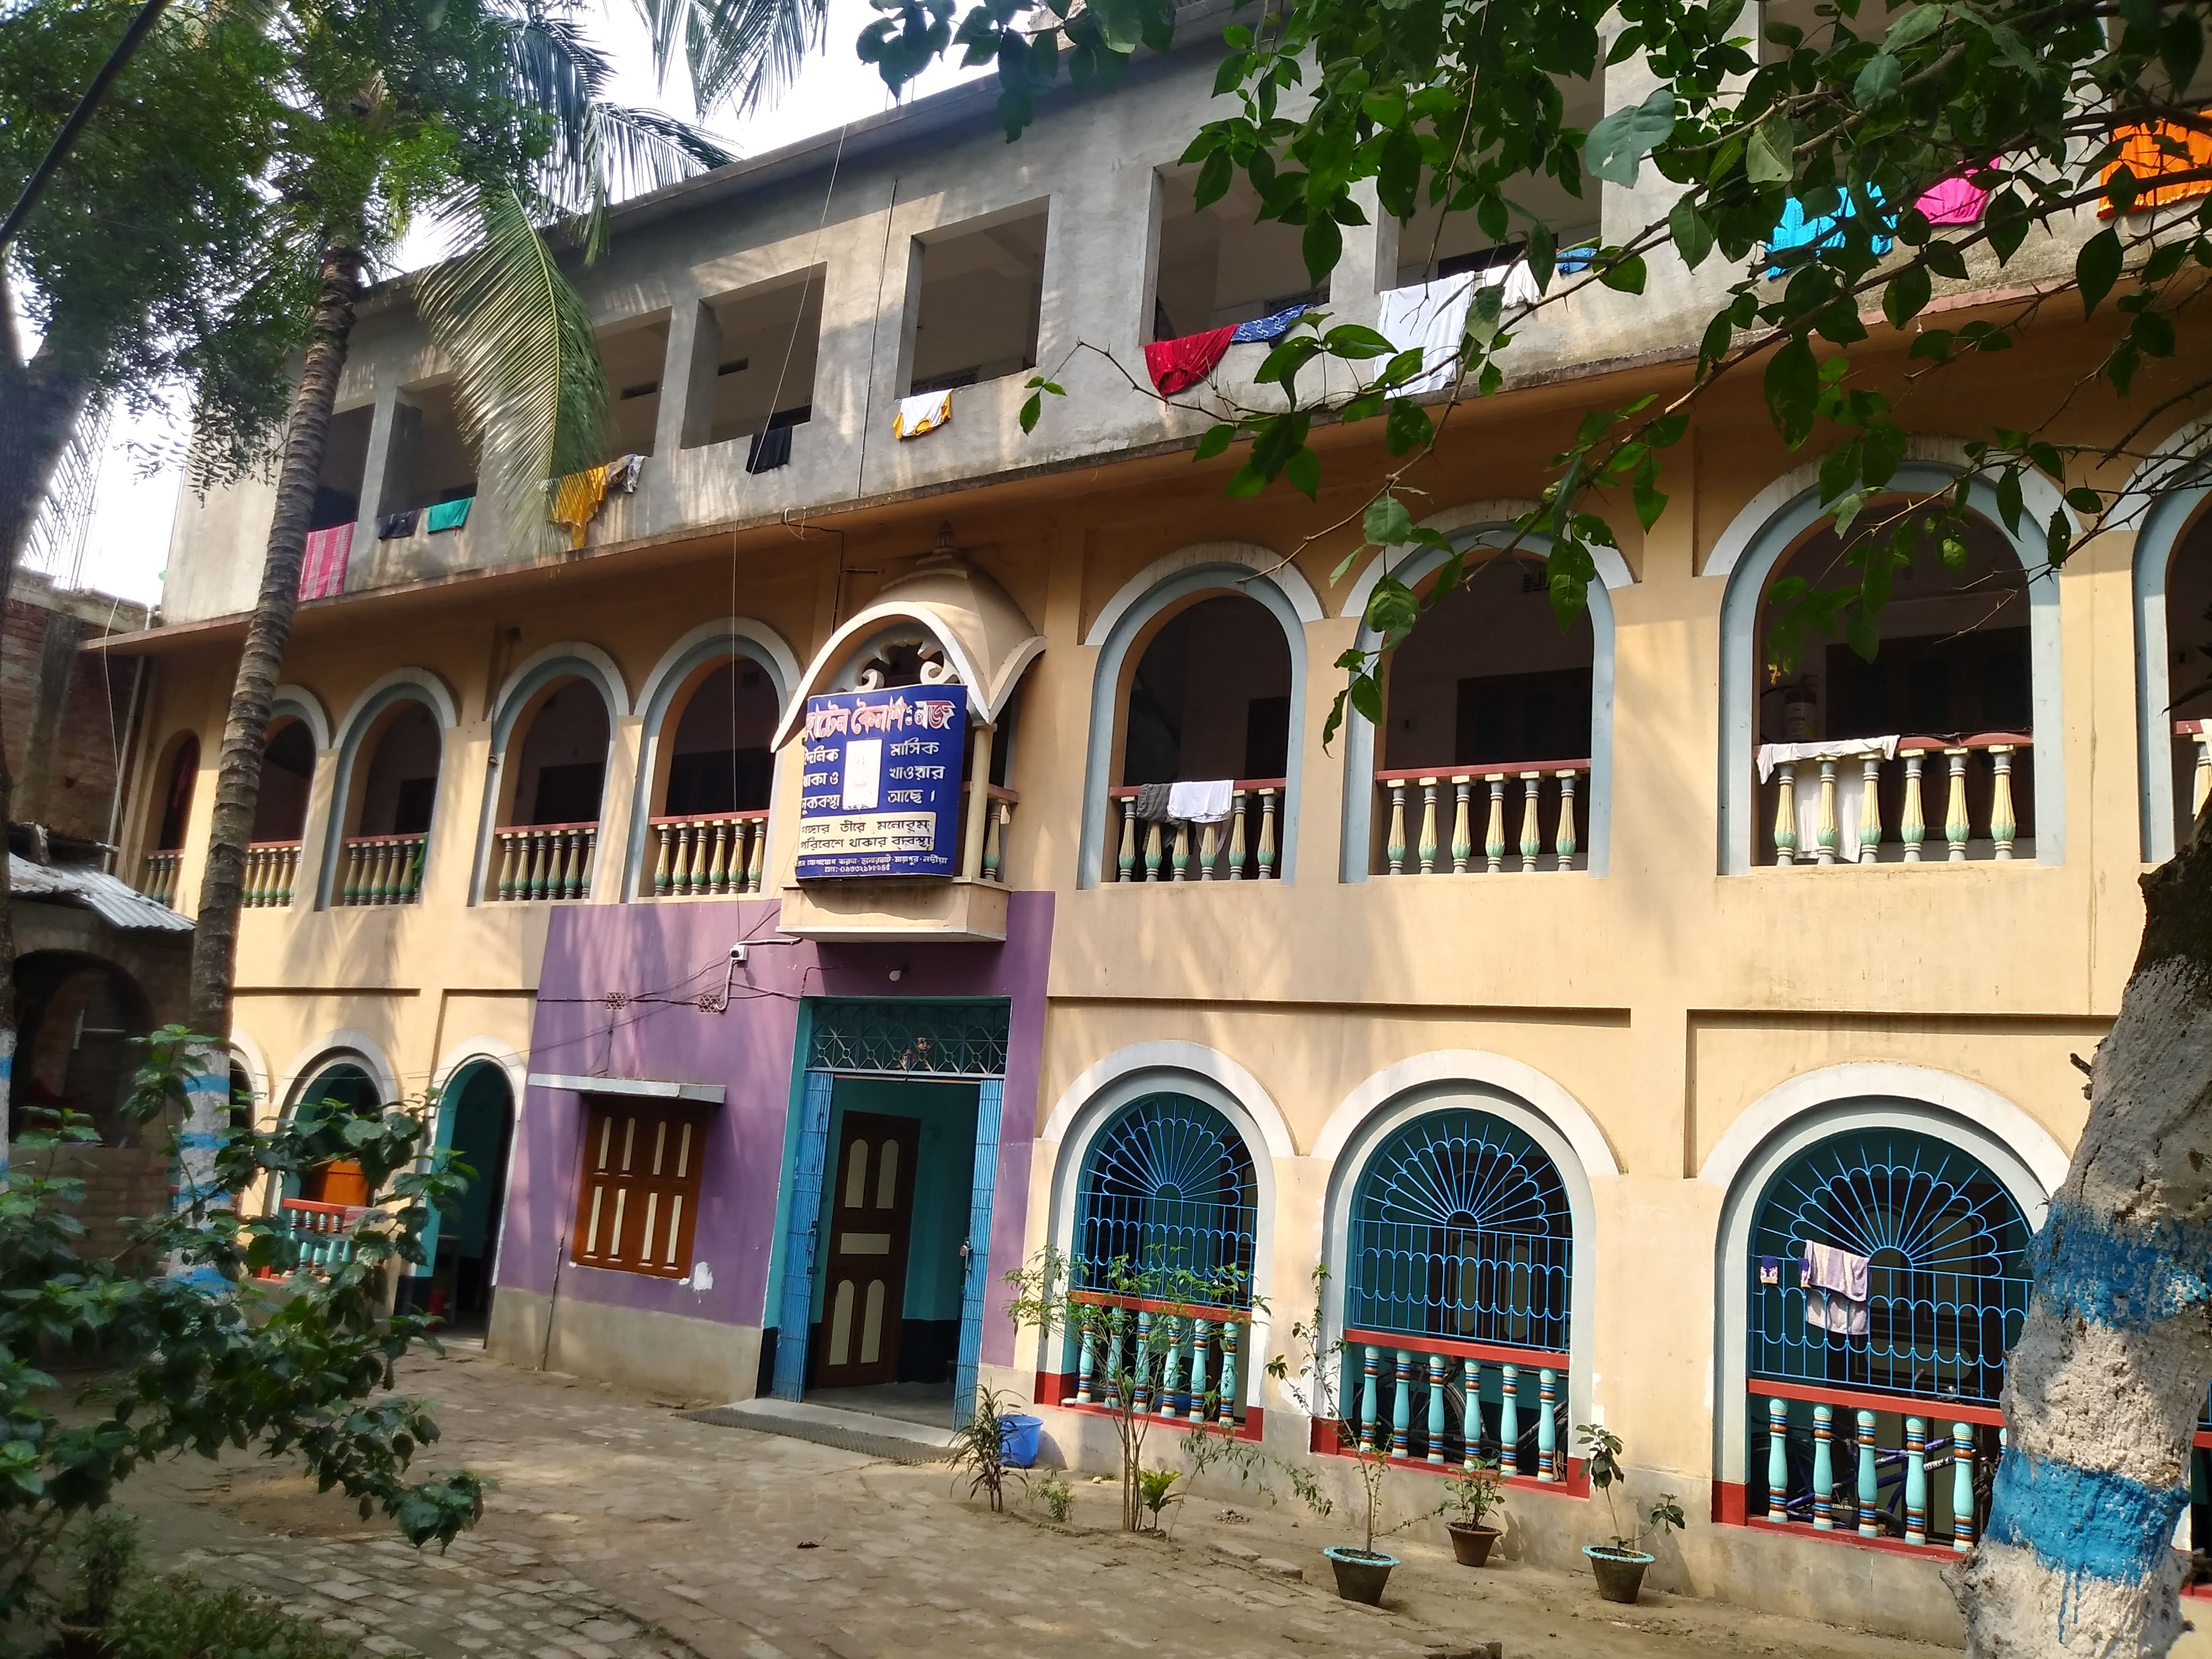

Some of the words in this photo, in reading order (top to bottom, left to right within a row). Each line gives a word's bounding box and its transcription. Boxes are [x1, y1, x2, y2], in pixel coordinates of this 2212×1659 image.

[889, 736, 940, 756] মাসিক
[830, 772, 839, 784] ও
[889, 766, 946, 781] খাওয়ার
[887, 789, 924, 804] আছে
[802, 824, 831, 834] গঙ্গার
[840, 819, 867, 833] তীরে
[801, 836, 844, 851] পরিবেশে
[849, 837, 888, 848] থাকার
[891, 836, 933, 848] ব্যবস্থা
